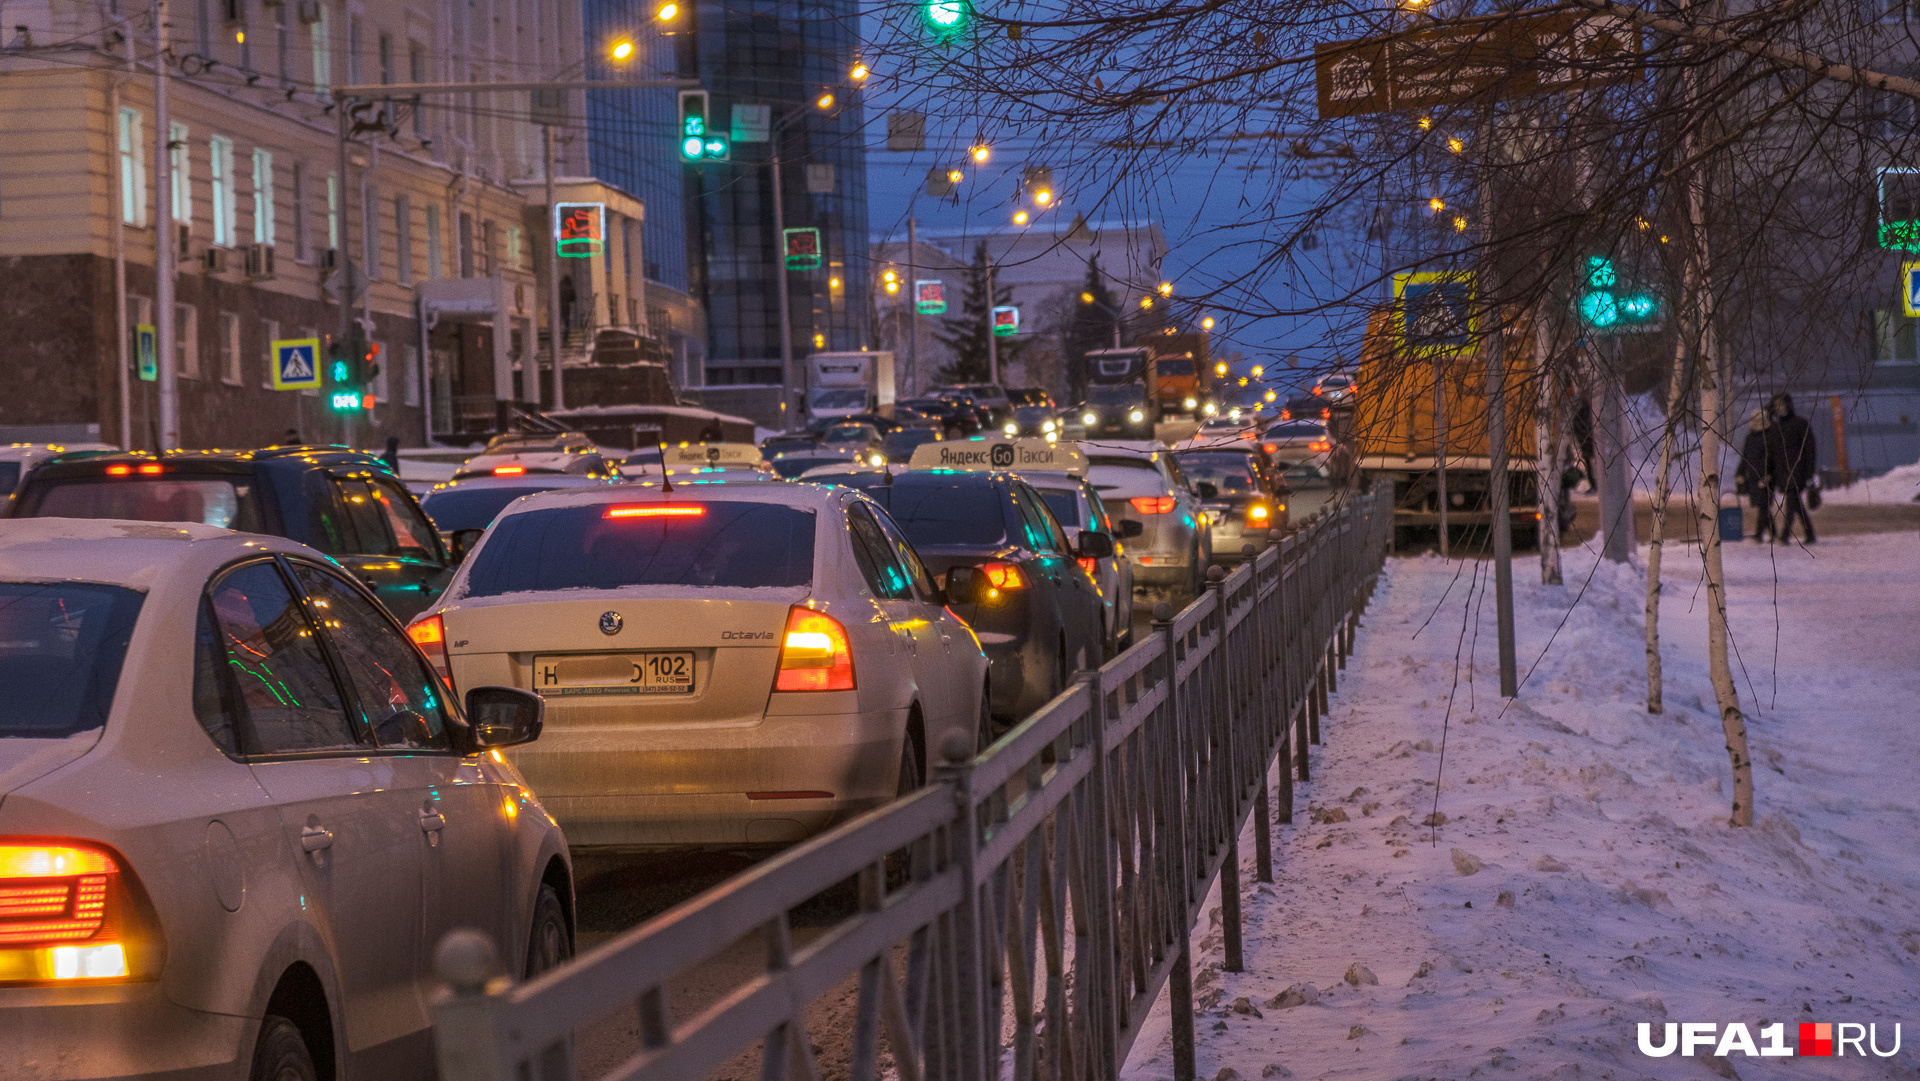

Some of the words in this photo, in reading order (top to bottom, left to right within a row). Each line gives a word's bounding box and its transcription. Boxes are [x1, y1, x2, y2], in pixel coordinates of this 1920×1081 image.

[941, 447, 987, 465] Яндекс
[992, 445, 1013, 465] Go
[1018, 447, 1054, 463] Такси
[721, 631, 775, 639] Octavia
[648, 656, 686, 676] 102
[655, 676, 675, 684] RUS
[564, 687, 603, 695] БАРС-АВТО
